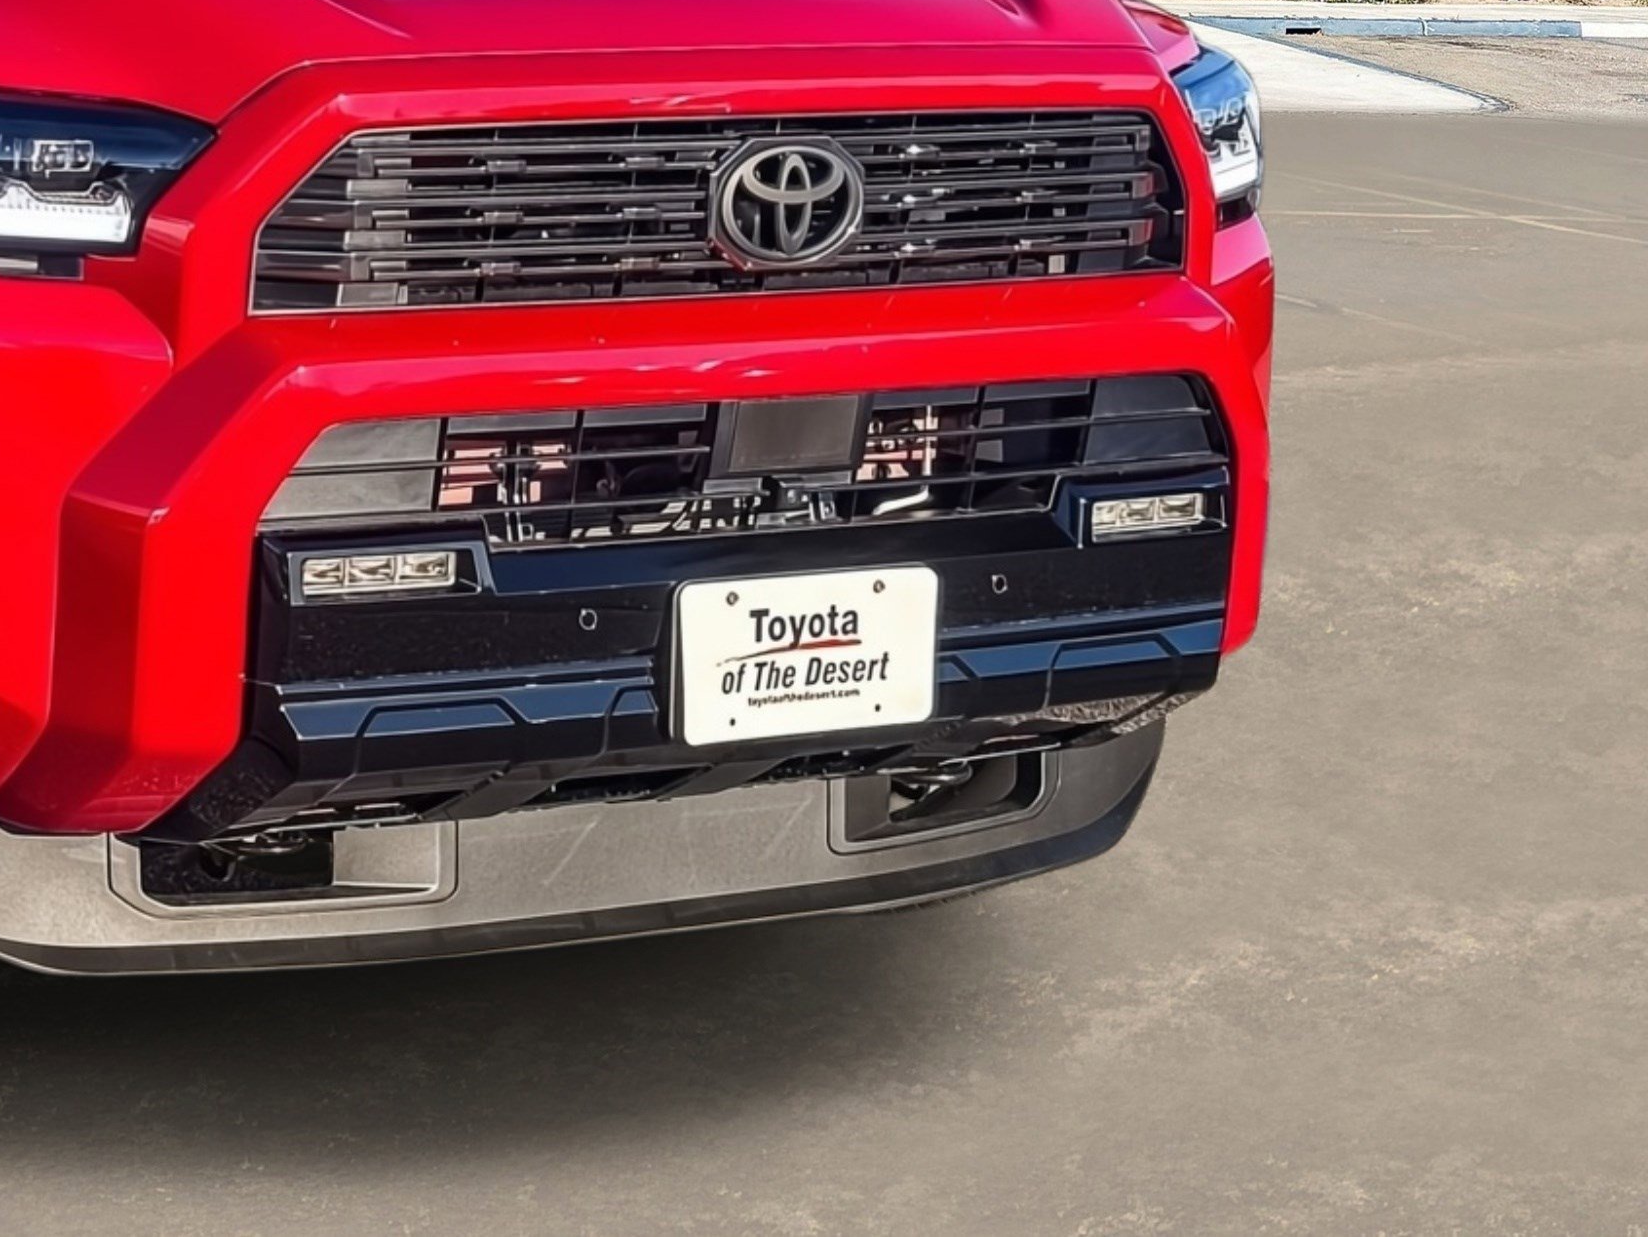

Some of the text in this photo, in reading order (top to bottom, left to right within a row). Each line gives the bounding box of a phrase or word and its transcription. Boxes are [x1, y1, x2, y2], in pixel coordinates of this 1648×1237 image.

[748, 604, 860, 649] Toyota
[721, 650, 890, 695] of The Desert
